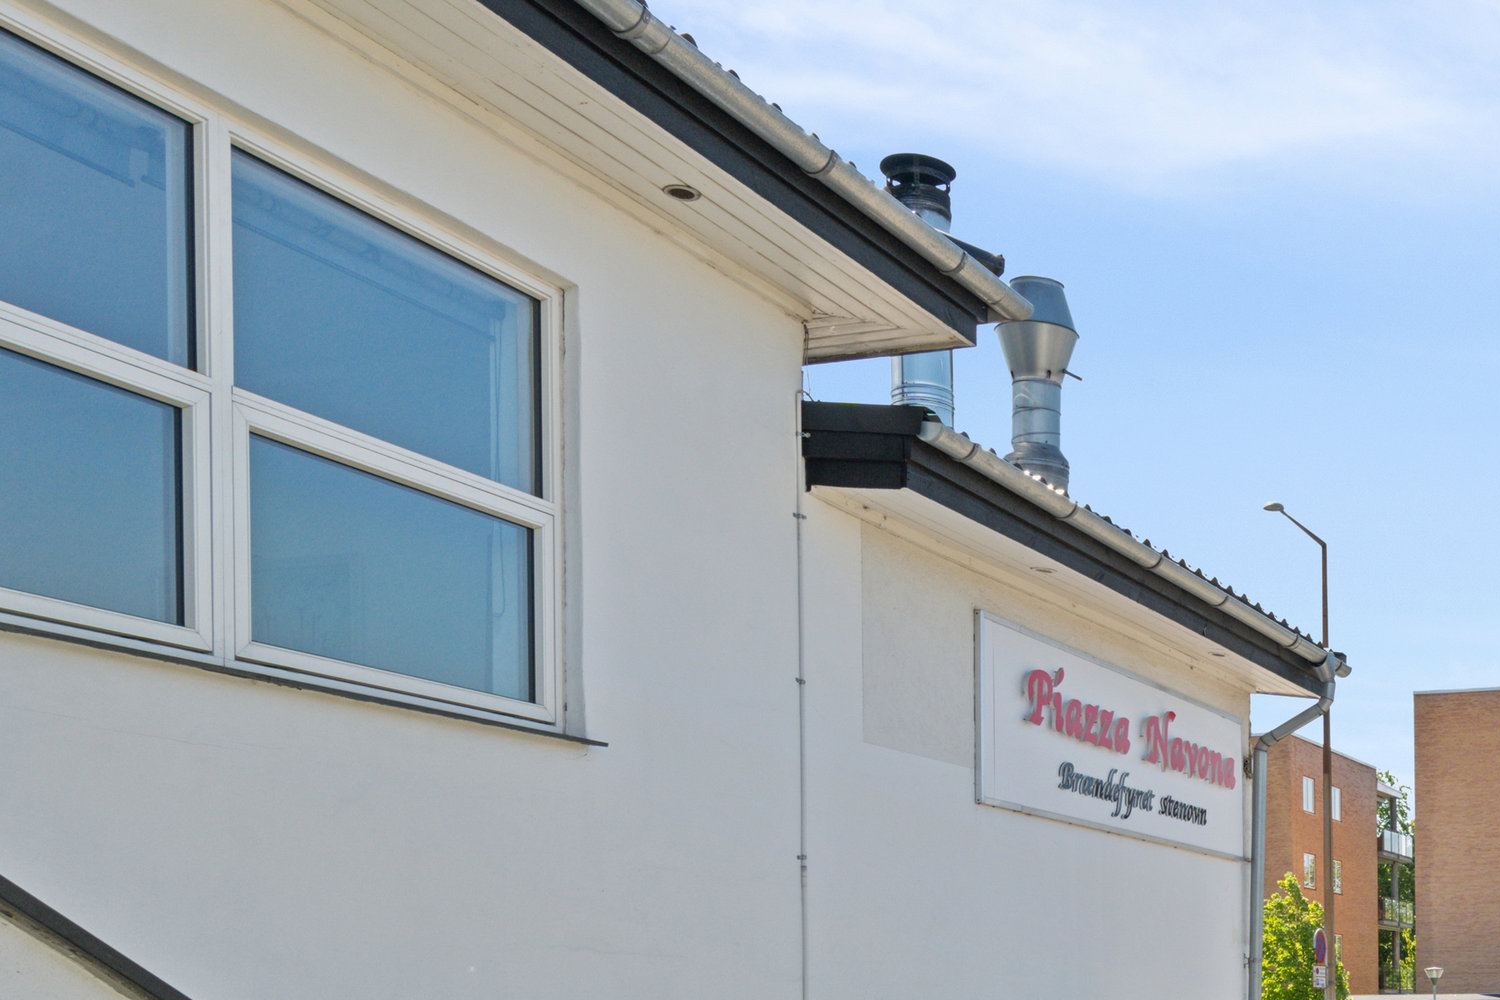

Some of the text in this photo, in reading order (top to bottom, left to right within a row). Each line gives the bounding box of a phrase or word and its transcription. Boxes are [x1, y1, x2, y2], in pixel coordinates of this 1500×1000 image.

[1025, 667, 1236, 790] Piazza Navona
[1159, 795, 1207, 826] stenovn
